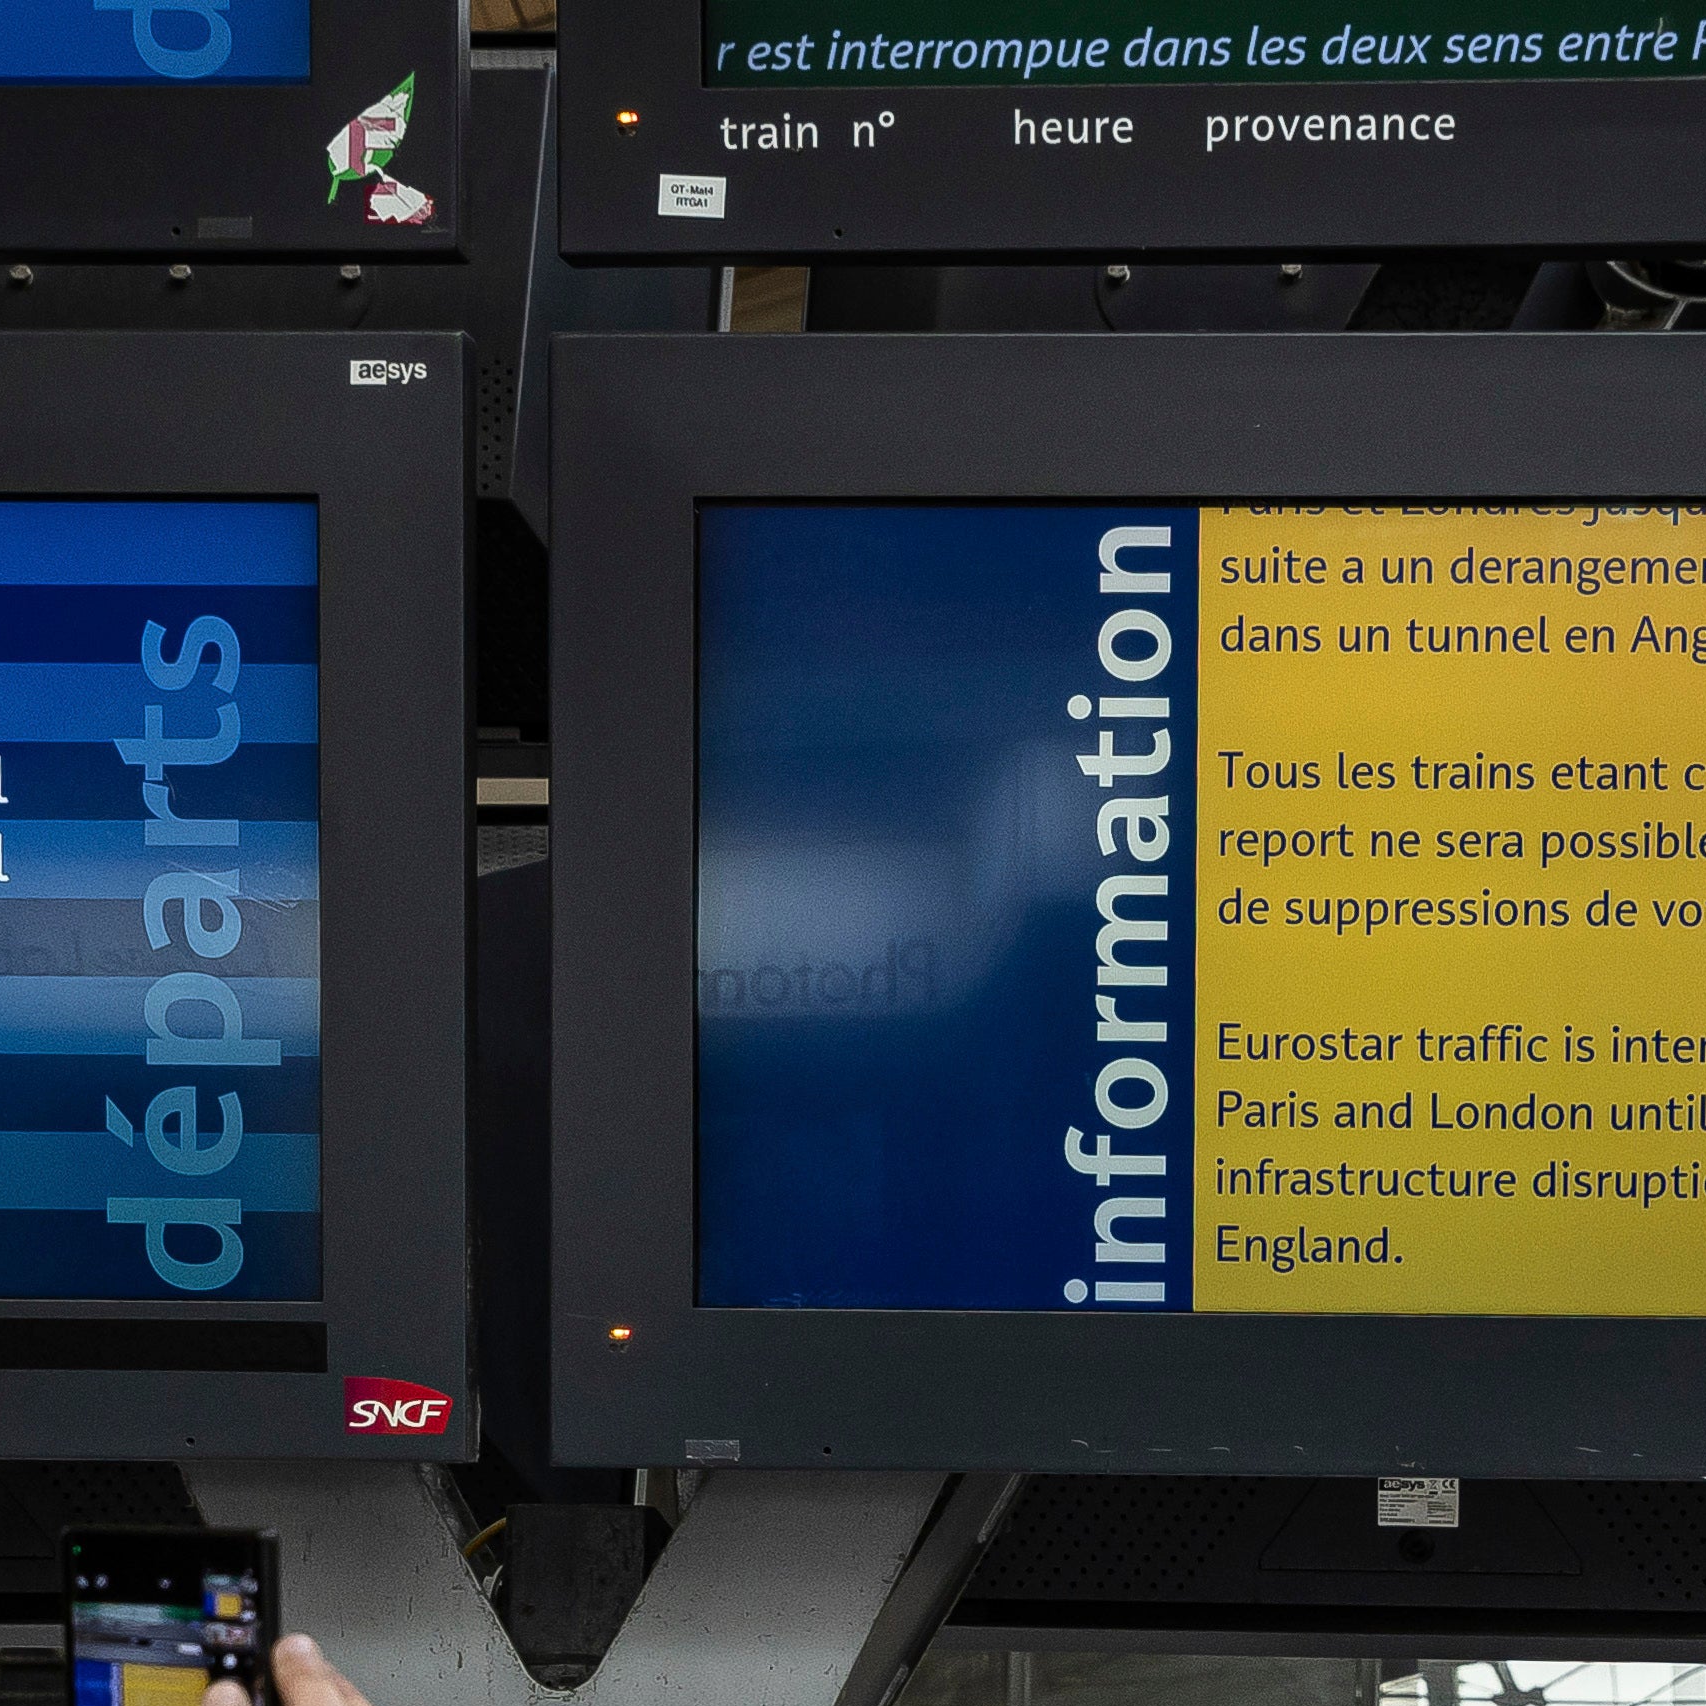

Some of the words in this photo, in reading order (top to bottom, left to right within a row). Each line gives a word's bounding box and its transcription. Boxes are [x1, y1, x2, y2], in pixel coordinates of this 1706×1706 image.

[748, 35, 814, 70] est
[828, 31, 1109, 78] interrompue
[1124, 27, 1231, 66] dans
[1247, 26, 1306, 65] les
[1323, 25, 1431, 64] deux
[1444, 34, 1542, 63] sens
[1559, 18, 1677, 61] entre
[721, 113, 818, 150] train
[854, 111, 895, 147] n°
[1015, 109, 1134, 144] heure
[1207, 115, 1456, 151] provenance
[357, 361, 427, 384] aesys
[1220, 545, 1327, 584] suite
[1341, 557, 1364, 584] a
[1381, 557, 1433, 584] un
[1221, 614, 1321, 653] dans
[1339, 625, 1390, 653] un
[1405, 615, 1550, 653] tunnel
[1565, 626, 1615, 654] en
[1217, 751, 1321, 789] Tous
[1338, 751, 1396, 790] les
[1410, 751, 1535, 790] trains
[1551, 755, 1669, 791] etant
[1220, 823, 1354, 868] report
[1371, 830, 1421, 858] ne
[1436, 830, 1524, 858] sera
[1064, 526, 1172, 1303] information
[1218, 887, 1270, 925] de
[1285, 888, 1570, 936] suppressions
[1585, 889, 1638, 927] de
[106, 615, 282, 1291] départs
[1218, 1022, 1403, 1061] Eurostar
[1416, 1024, 1548, 1063] traffic
[1564, 1025, 1595, 1063] is
[1217, 1090, 1319, 1128] Paris
[1334, 1091, 1412, 1129] and
[1431, 1092, 1592, 1130] London
[1216, 1157, 1516, 1198] infrastructure
[1216, 1224, 1403, 1274] England.
[348, 1399, 448, 1429] SNCF
[1383, 1480, 1426, 1491] aesys
